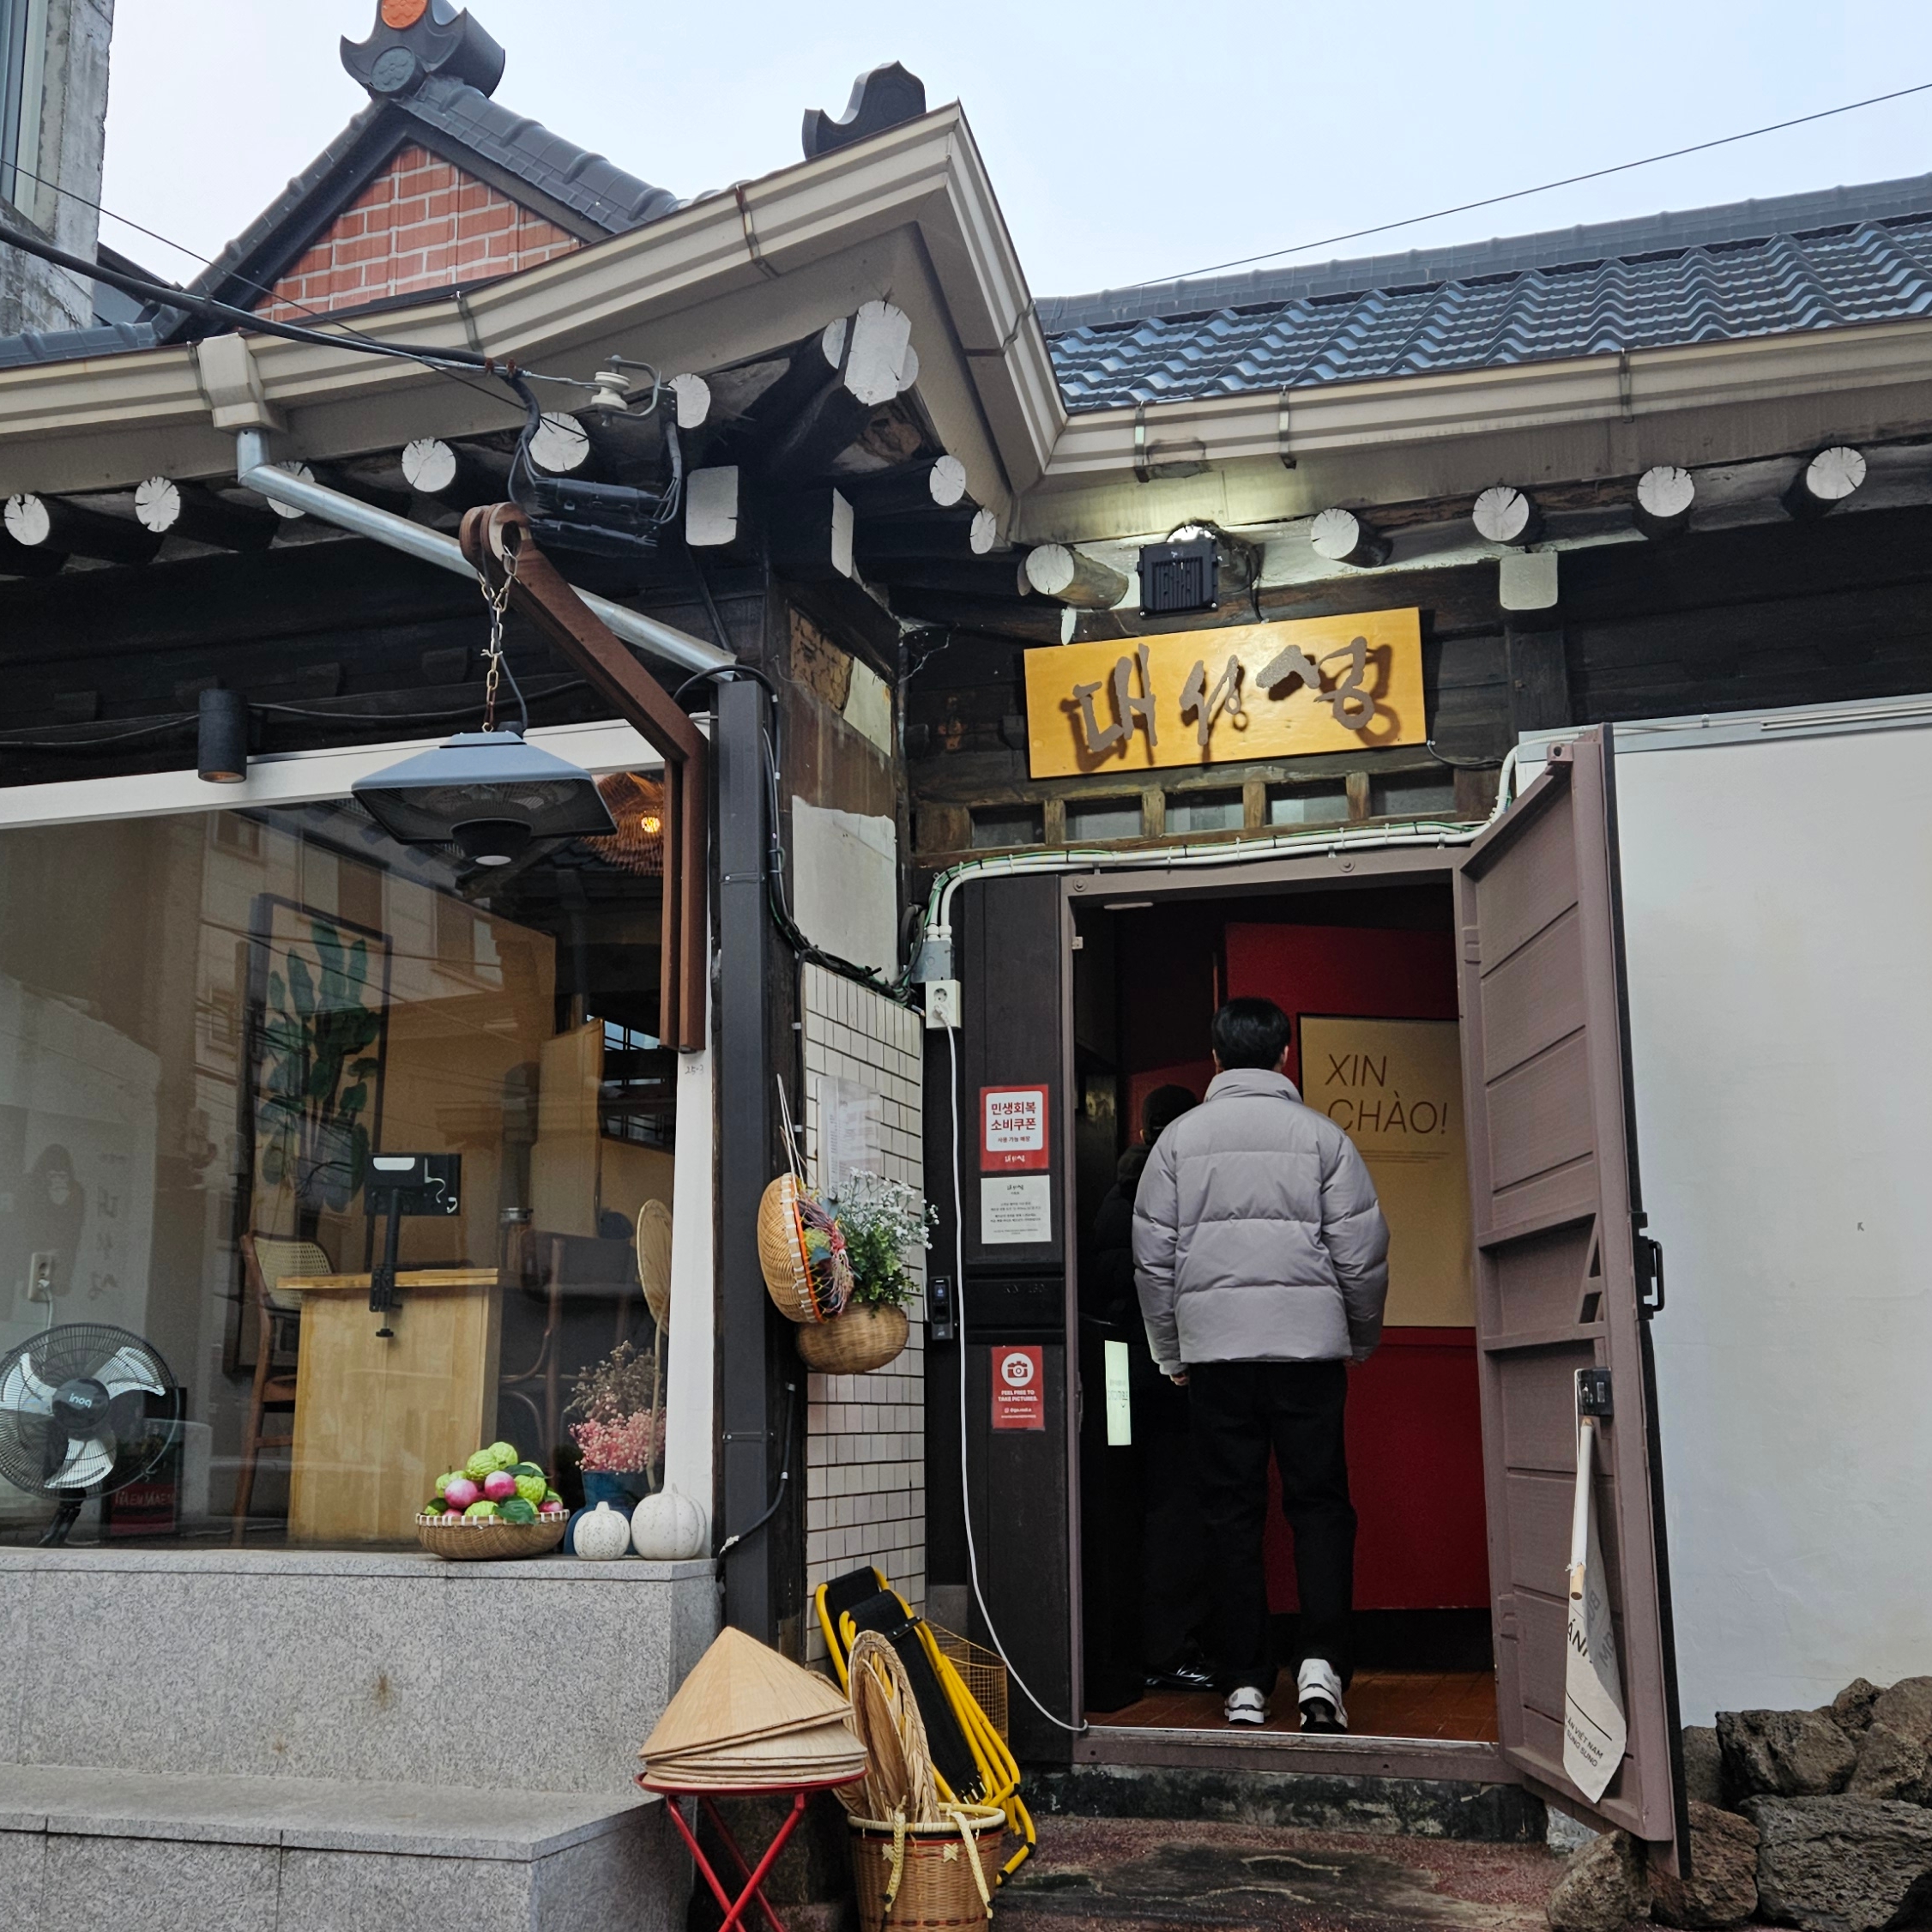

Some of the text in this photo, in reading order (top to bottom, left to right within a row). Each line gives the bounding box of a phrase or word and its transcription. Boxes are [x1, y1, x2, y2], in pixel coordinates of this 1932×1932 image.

[1325, 1054, 1387, 1087] XIN
[991, 1102, 1036, 1115] 민생회복
[1328, 1090, 1447, 1134] CHÀO!
[991, 1118, 1036, 1131] 소비쿠폰
[1587, 1742, 1603, 1760] NAM
